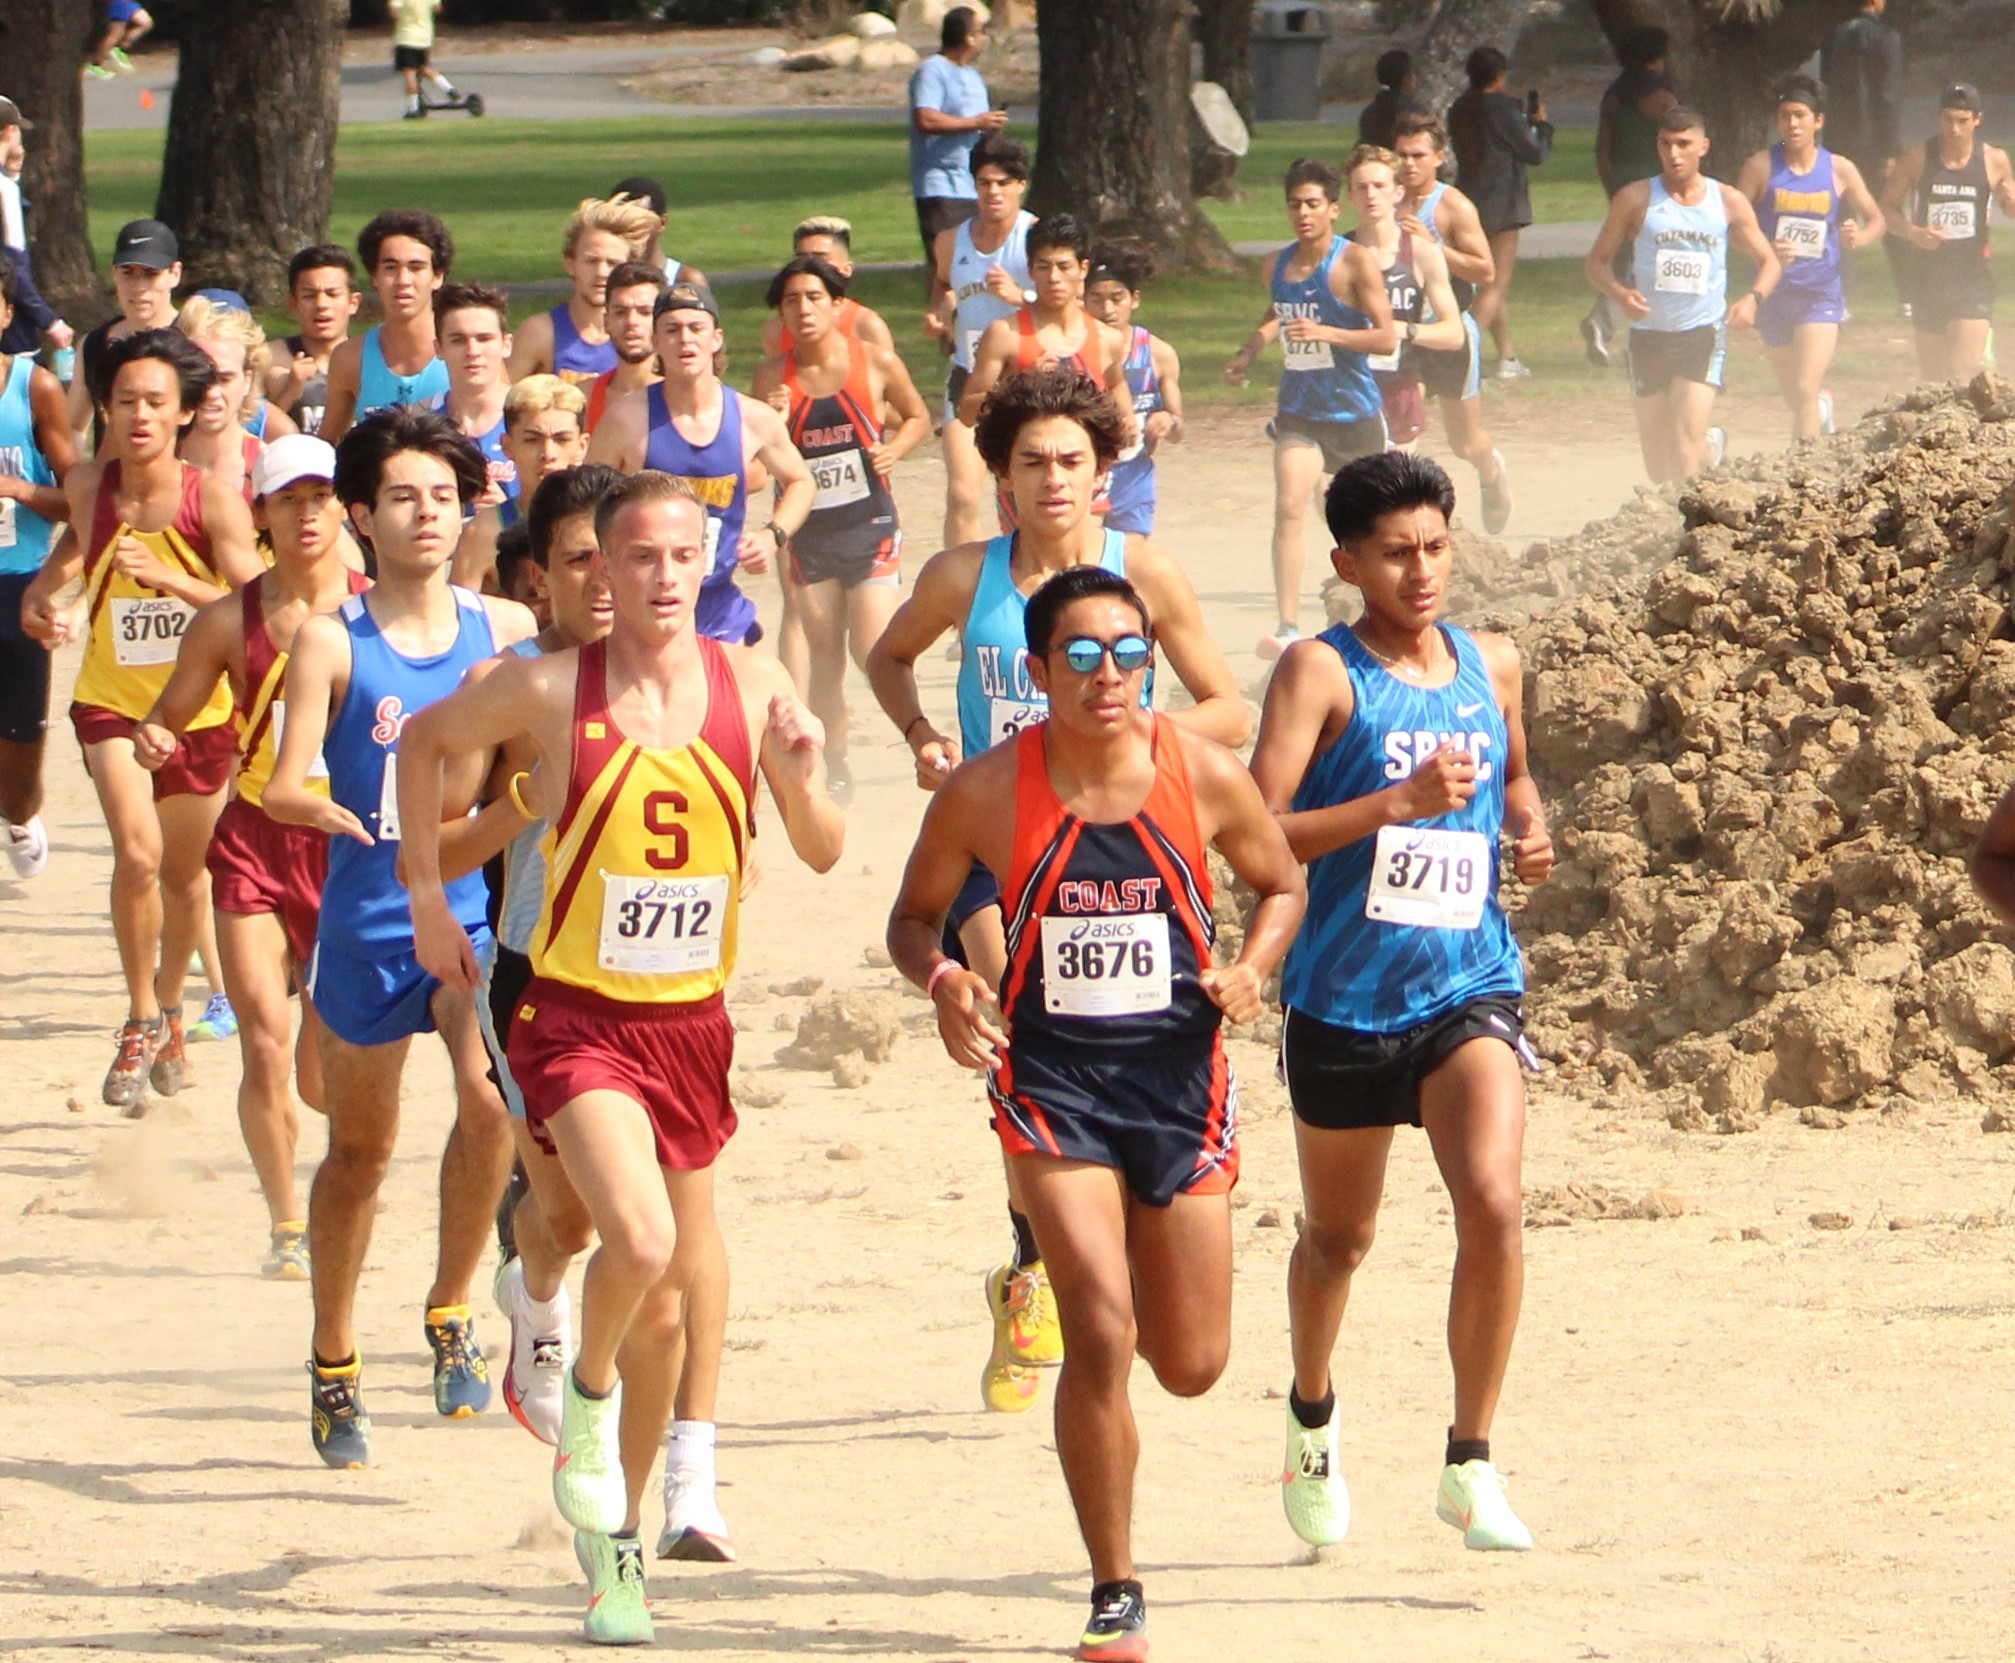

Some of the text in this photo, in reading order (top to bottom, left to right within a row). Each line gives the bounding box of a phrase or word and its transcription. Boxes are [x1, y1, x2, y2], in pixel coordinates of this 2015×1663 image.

[1931, 210, 1969, 226] 3735
[1662, 260, 1703, 279] 3603
[1384, 286, 1417, 310] AC
[802, 423, 854, 449] COAST
[142, 600, 174, 613] asics
[122, 611, 187, 642] 3702
[976, 645, 1008, 698] EL
[643, 790, 690, 870] S
[1425, 837, 1461, 851] asics
[1387, 850, 1474, 895] 3719
[657, 884, 700, 899] asics
[1058, 877, 1162, 913] COAST
[618, 899, 713, 940] 3712
[1091, 922, 1136, 938] asics
[1057, 939, 1154, 980] 3676
